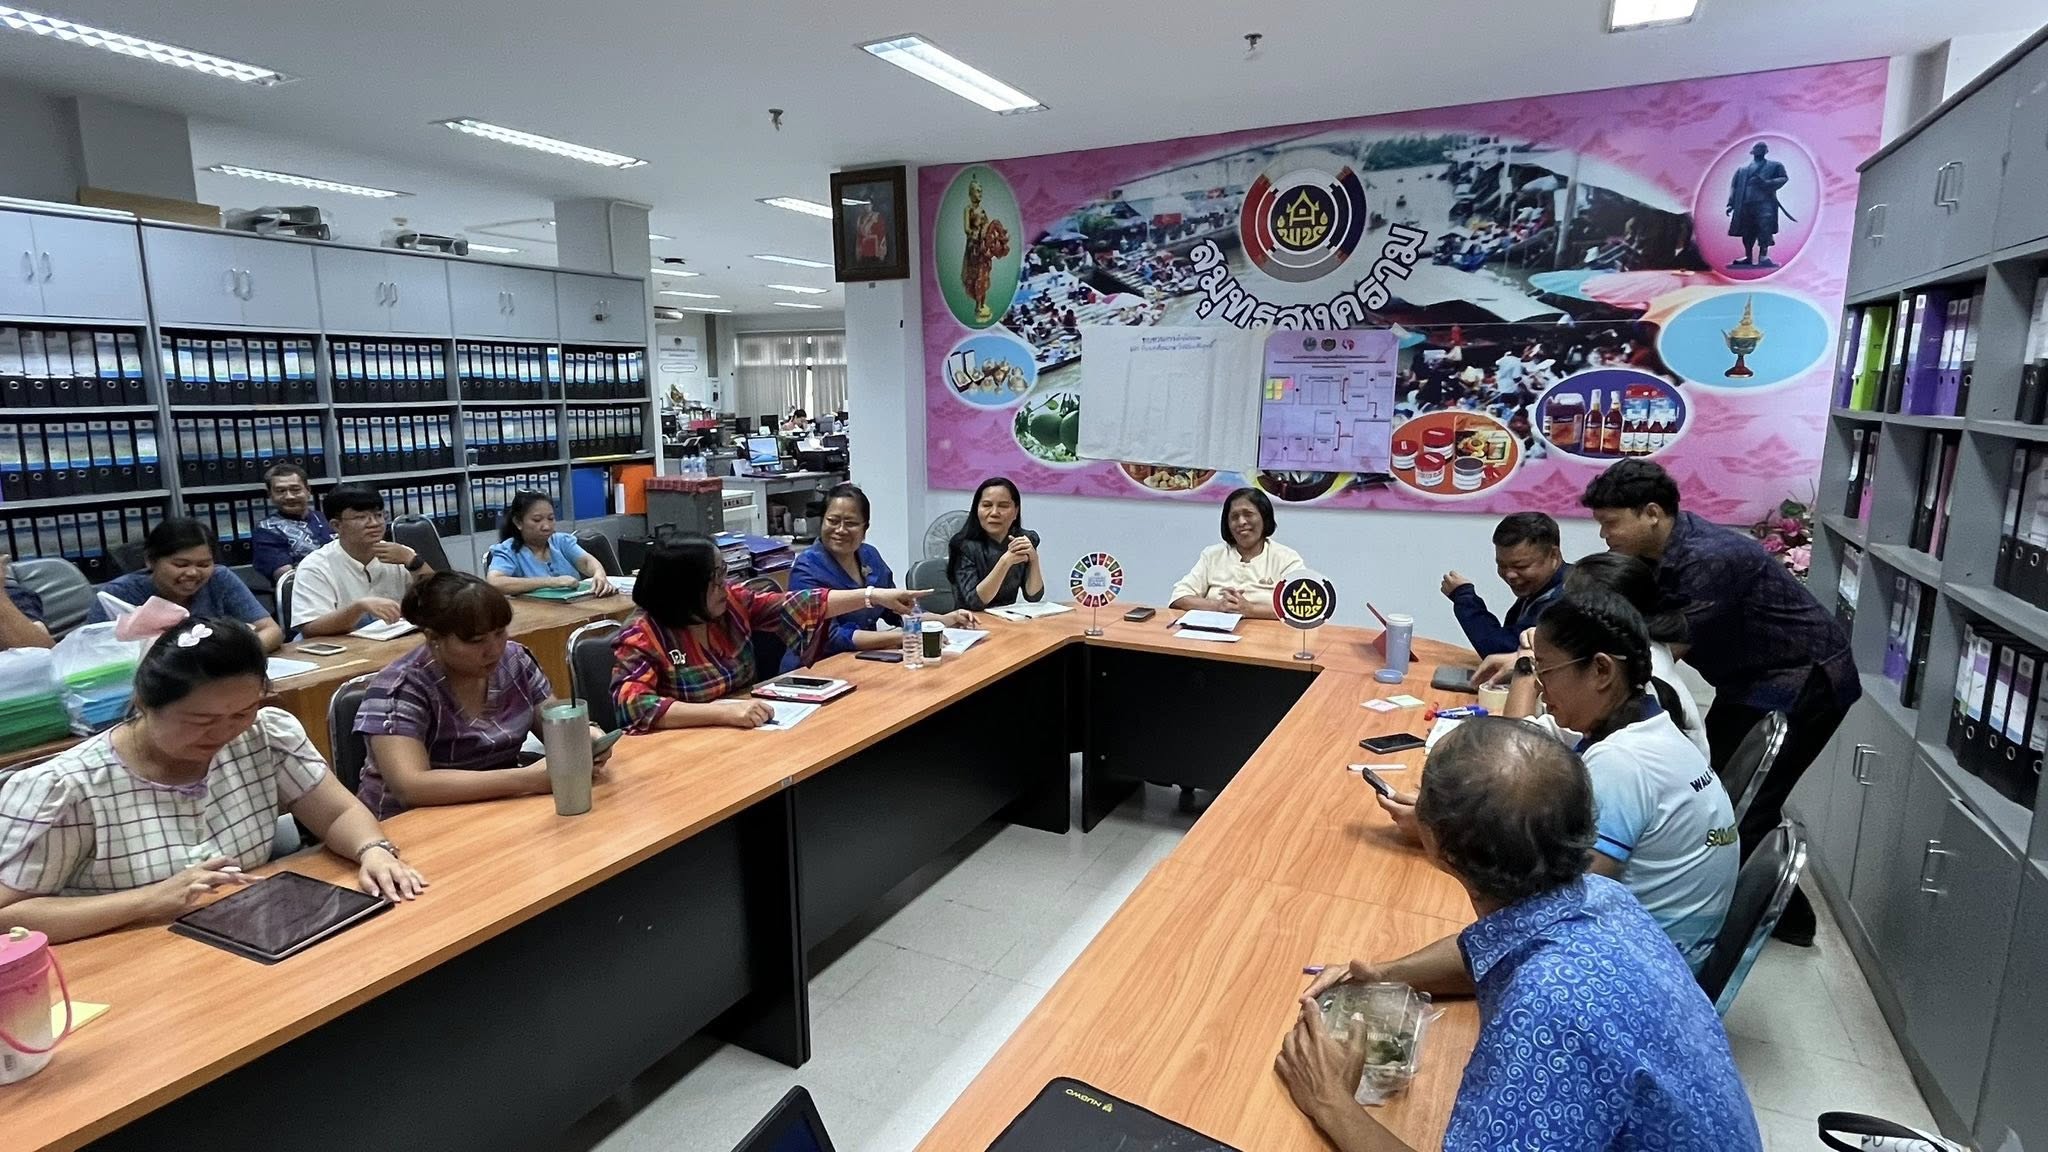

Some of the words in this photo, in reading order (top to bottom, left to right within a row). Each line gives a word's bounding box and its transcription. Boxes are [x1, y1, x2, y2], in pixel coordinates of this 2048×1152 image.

[1189, 222, 1428, 330] สมุทรสงคราม
[1065, 1088, 1102, 1107] NUBWO
